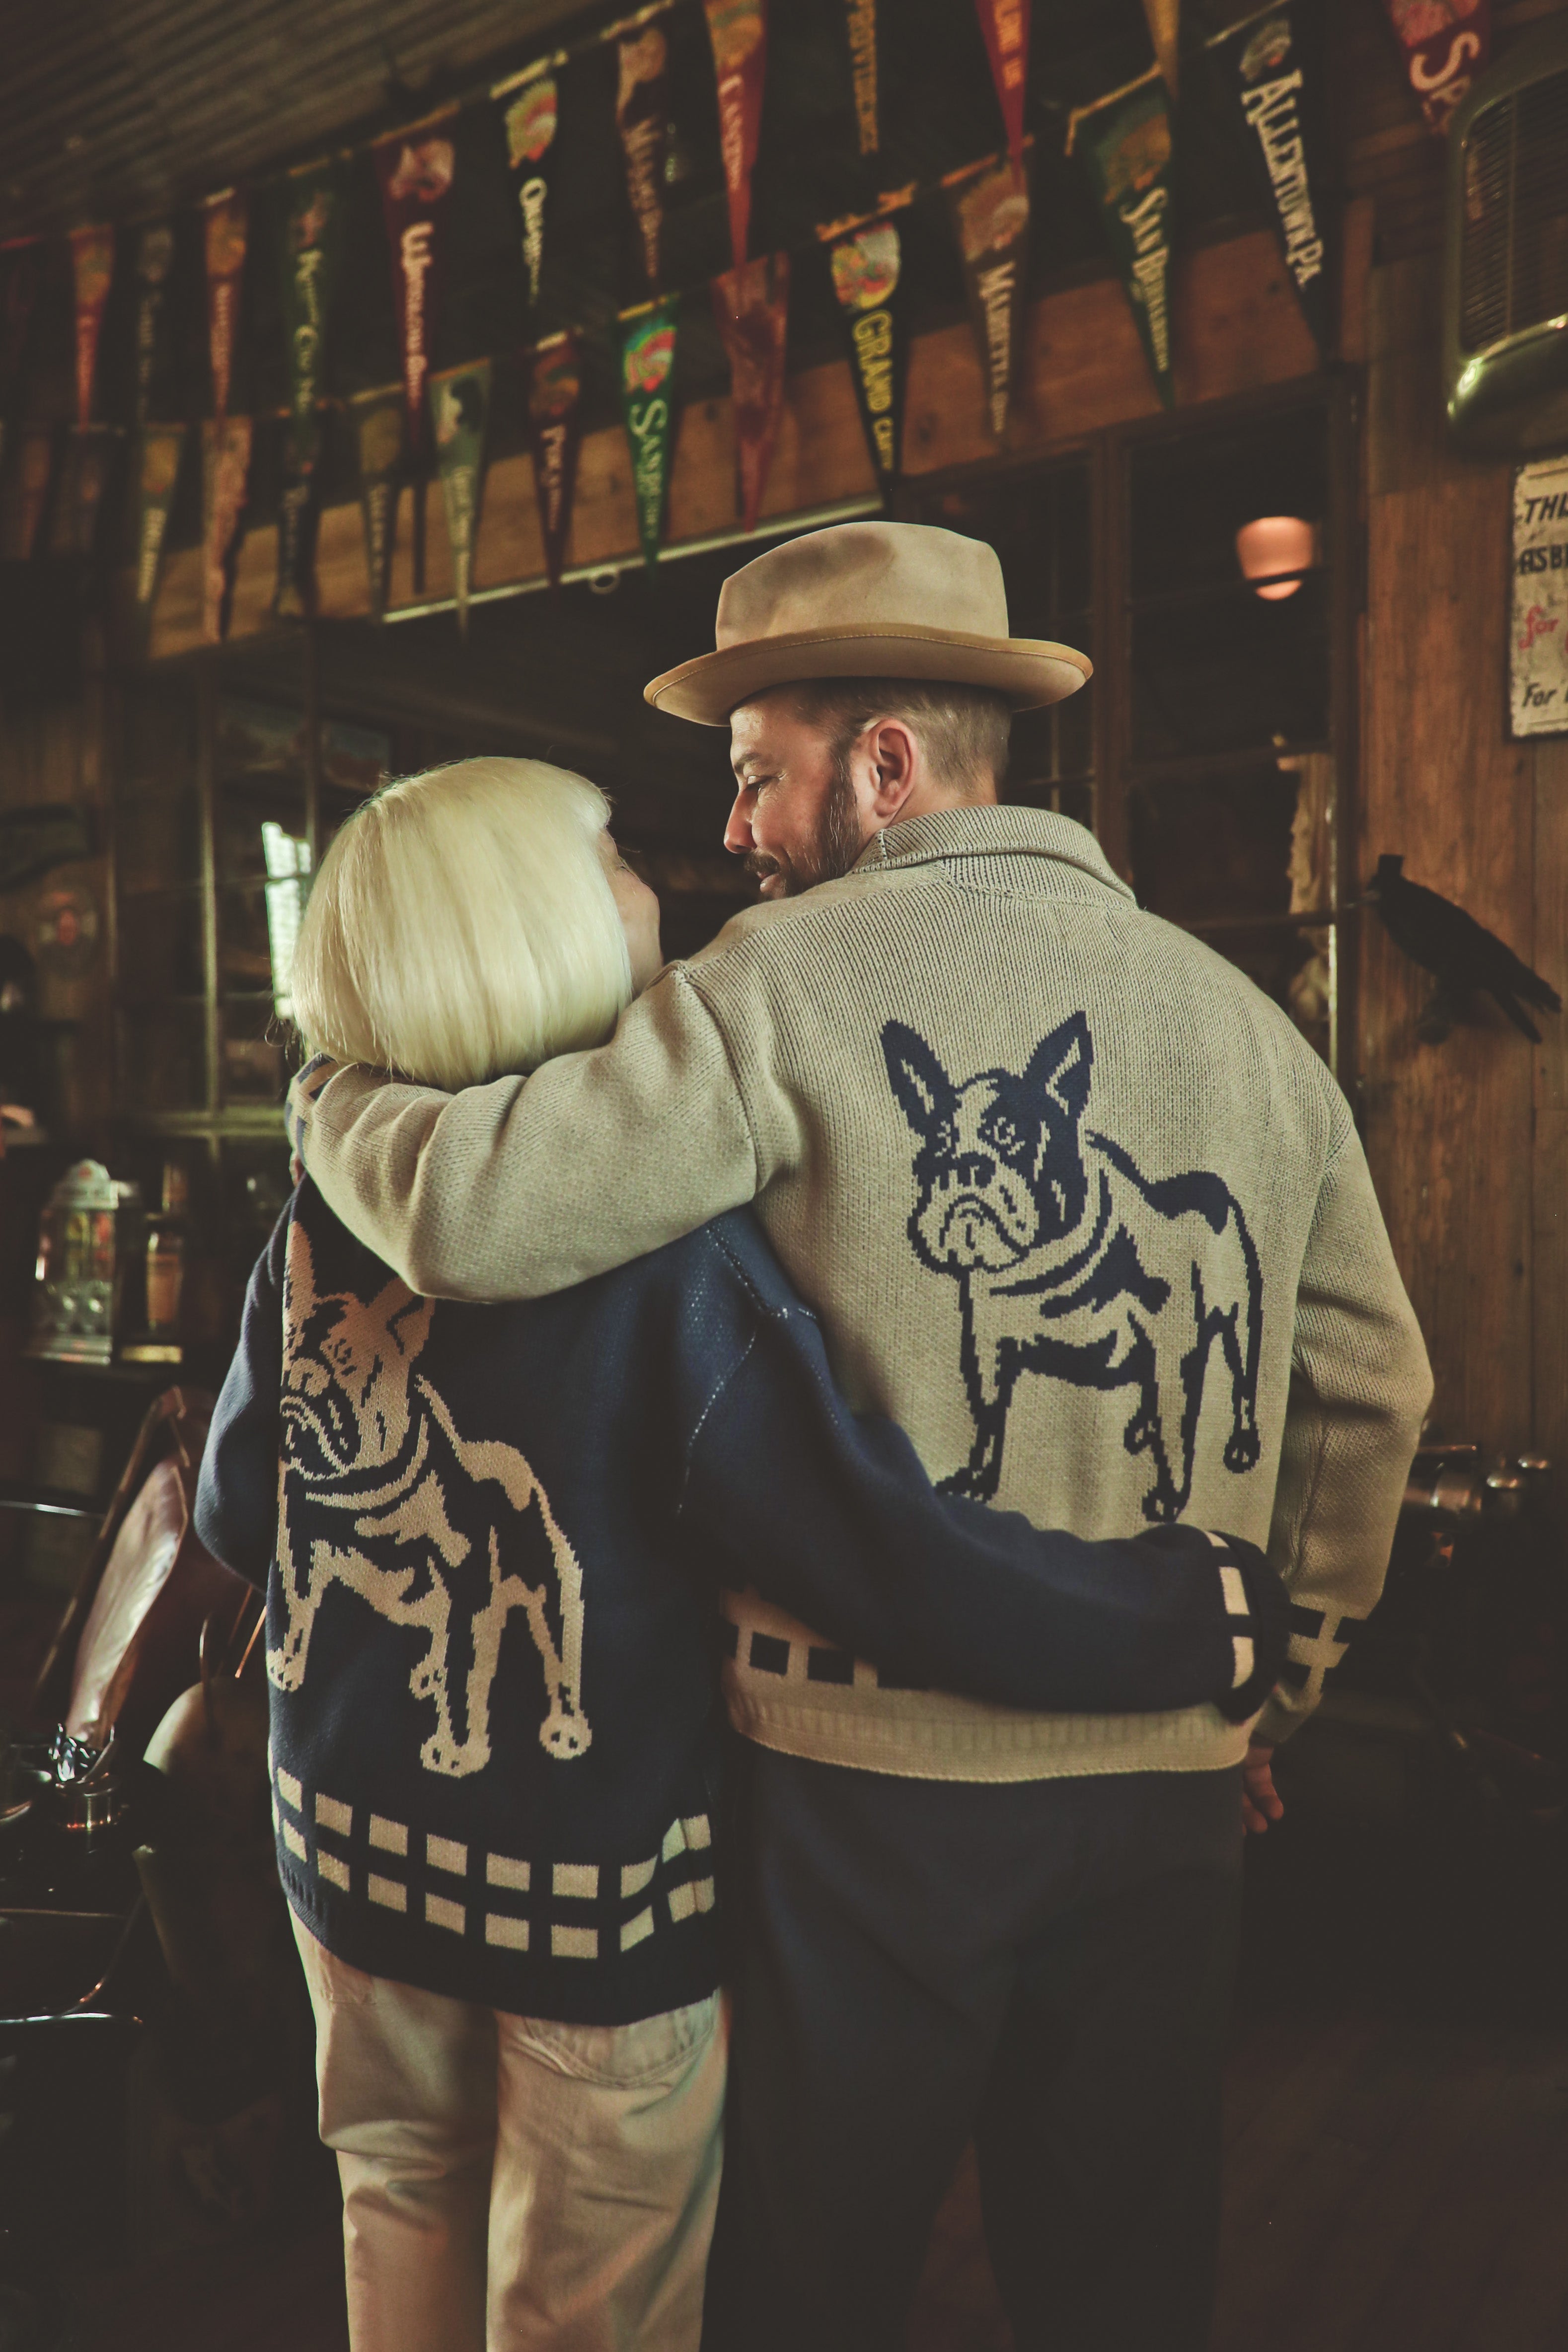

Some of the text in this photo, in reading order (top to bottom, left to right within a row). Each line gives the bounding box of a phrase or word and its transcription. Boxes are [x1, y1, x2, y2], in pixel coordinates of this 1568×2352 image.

[852, 309, 893, 413] GRAND
[1520, 543, 1568, 575] ASB
[1518, 605, 1560, 650] for
[1522, 682, 1558, 707] For
